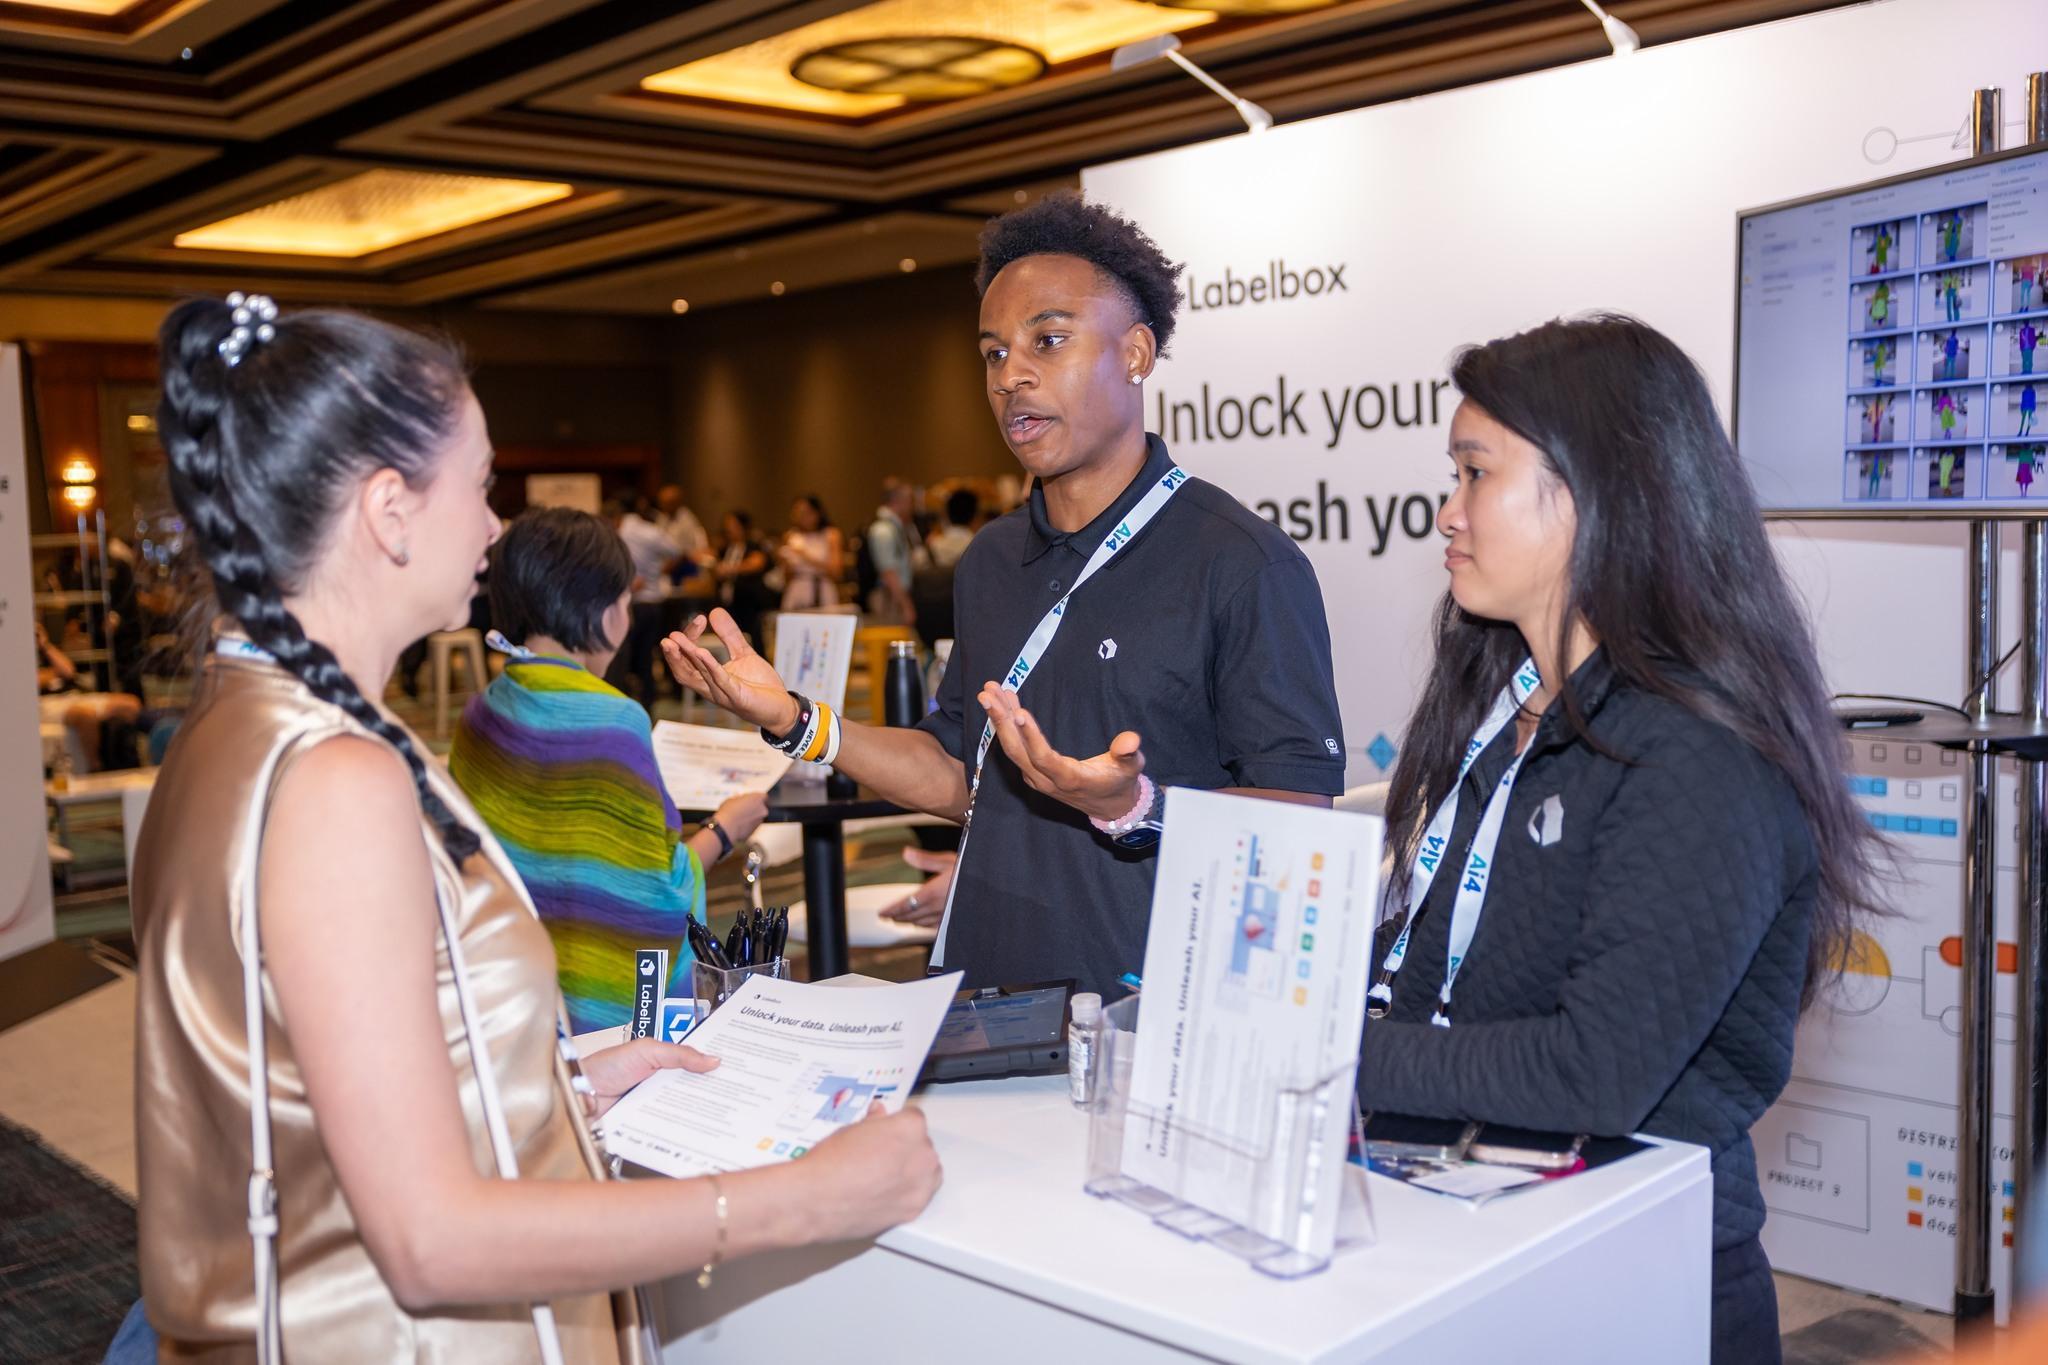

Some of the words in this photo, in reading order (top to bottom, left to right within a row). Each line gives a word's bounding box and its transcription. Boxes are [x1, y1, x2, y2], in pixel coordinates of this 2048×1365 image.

[1188, 259, 1348, 311] Labelbox
[1321, 377, 1449, 449] your
[1161, 467, 1187, 491] Ai4
[1105, 521, 1132, 551] Ai4
[1365, 492, 1449, 557] yo
[1008, 656, 1030, 688] Ai4
[1518, 665, 1541, 692] Ai
[1419, 835, 1445, 874] Ai4
[1463, 854, 1487, 893] Ai4
[638, 984, 653, 1039] Labelbo
[740, 1005, 776, 1022] Unlock
[775, 1015, 800, 1028] your
[800, 1019, 826, 1032] data.
[828, 1022, 867, 1034] Unleash
[866, 1024, 889, 1036] your
[1168, 1063, 1179, 1097] your
[1178, 945, 1194, 1011] Unleash
[1189, 906, 1198, 940] your
[1767, 1169, 1824, 1193] PROJECT
